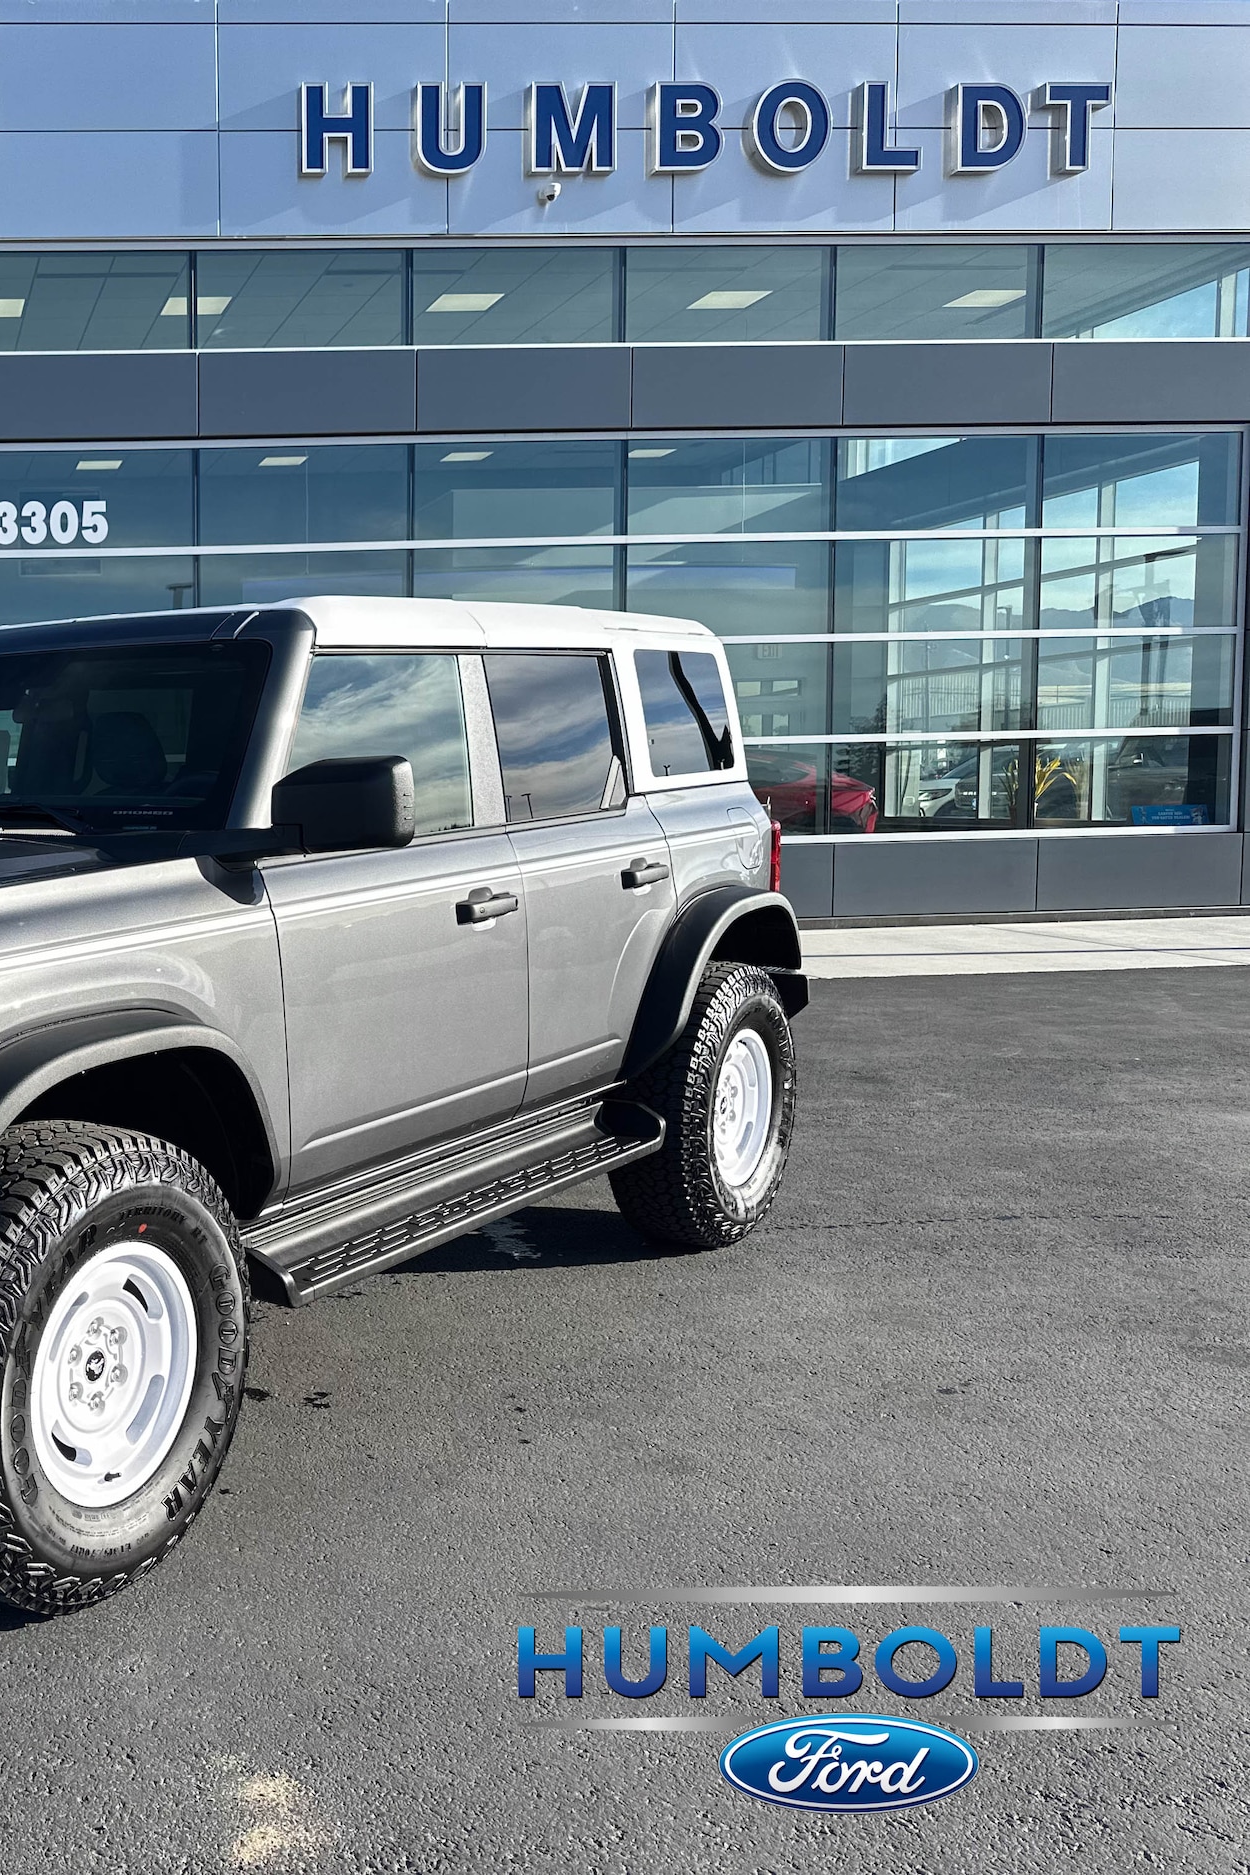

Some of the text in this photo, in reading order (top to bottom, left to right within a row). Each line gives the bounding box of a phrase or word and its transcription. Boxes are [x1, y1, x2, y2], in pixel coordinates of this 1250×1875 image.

[300, 79, 1113, 176] HUMBOLDT
[119, 1206, 188, 1225] TERRITORY
[160, 1264, 238, 1521] GOODYEAR
